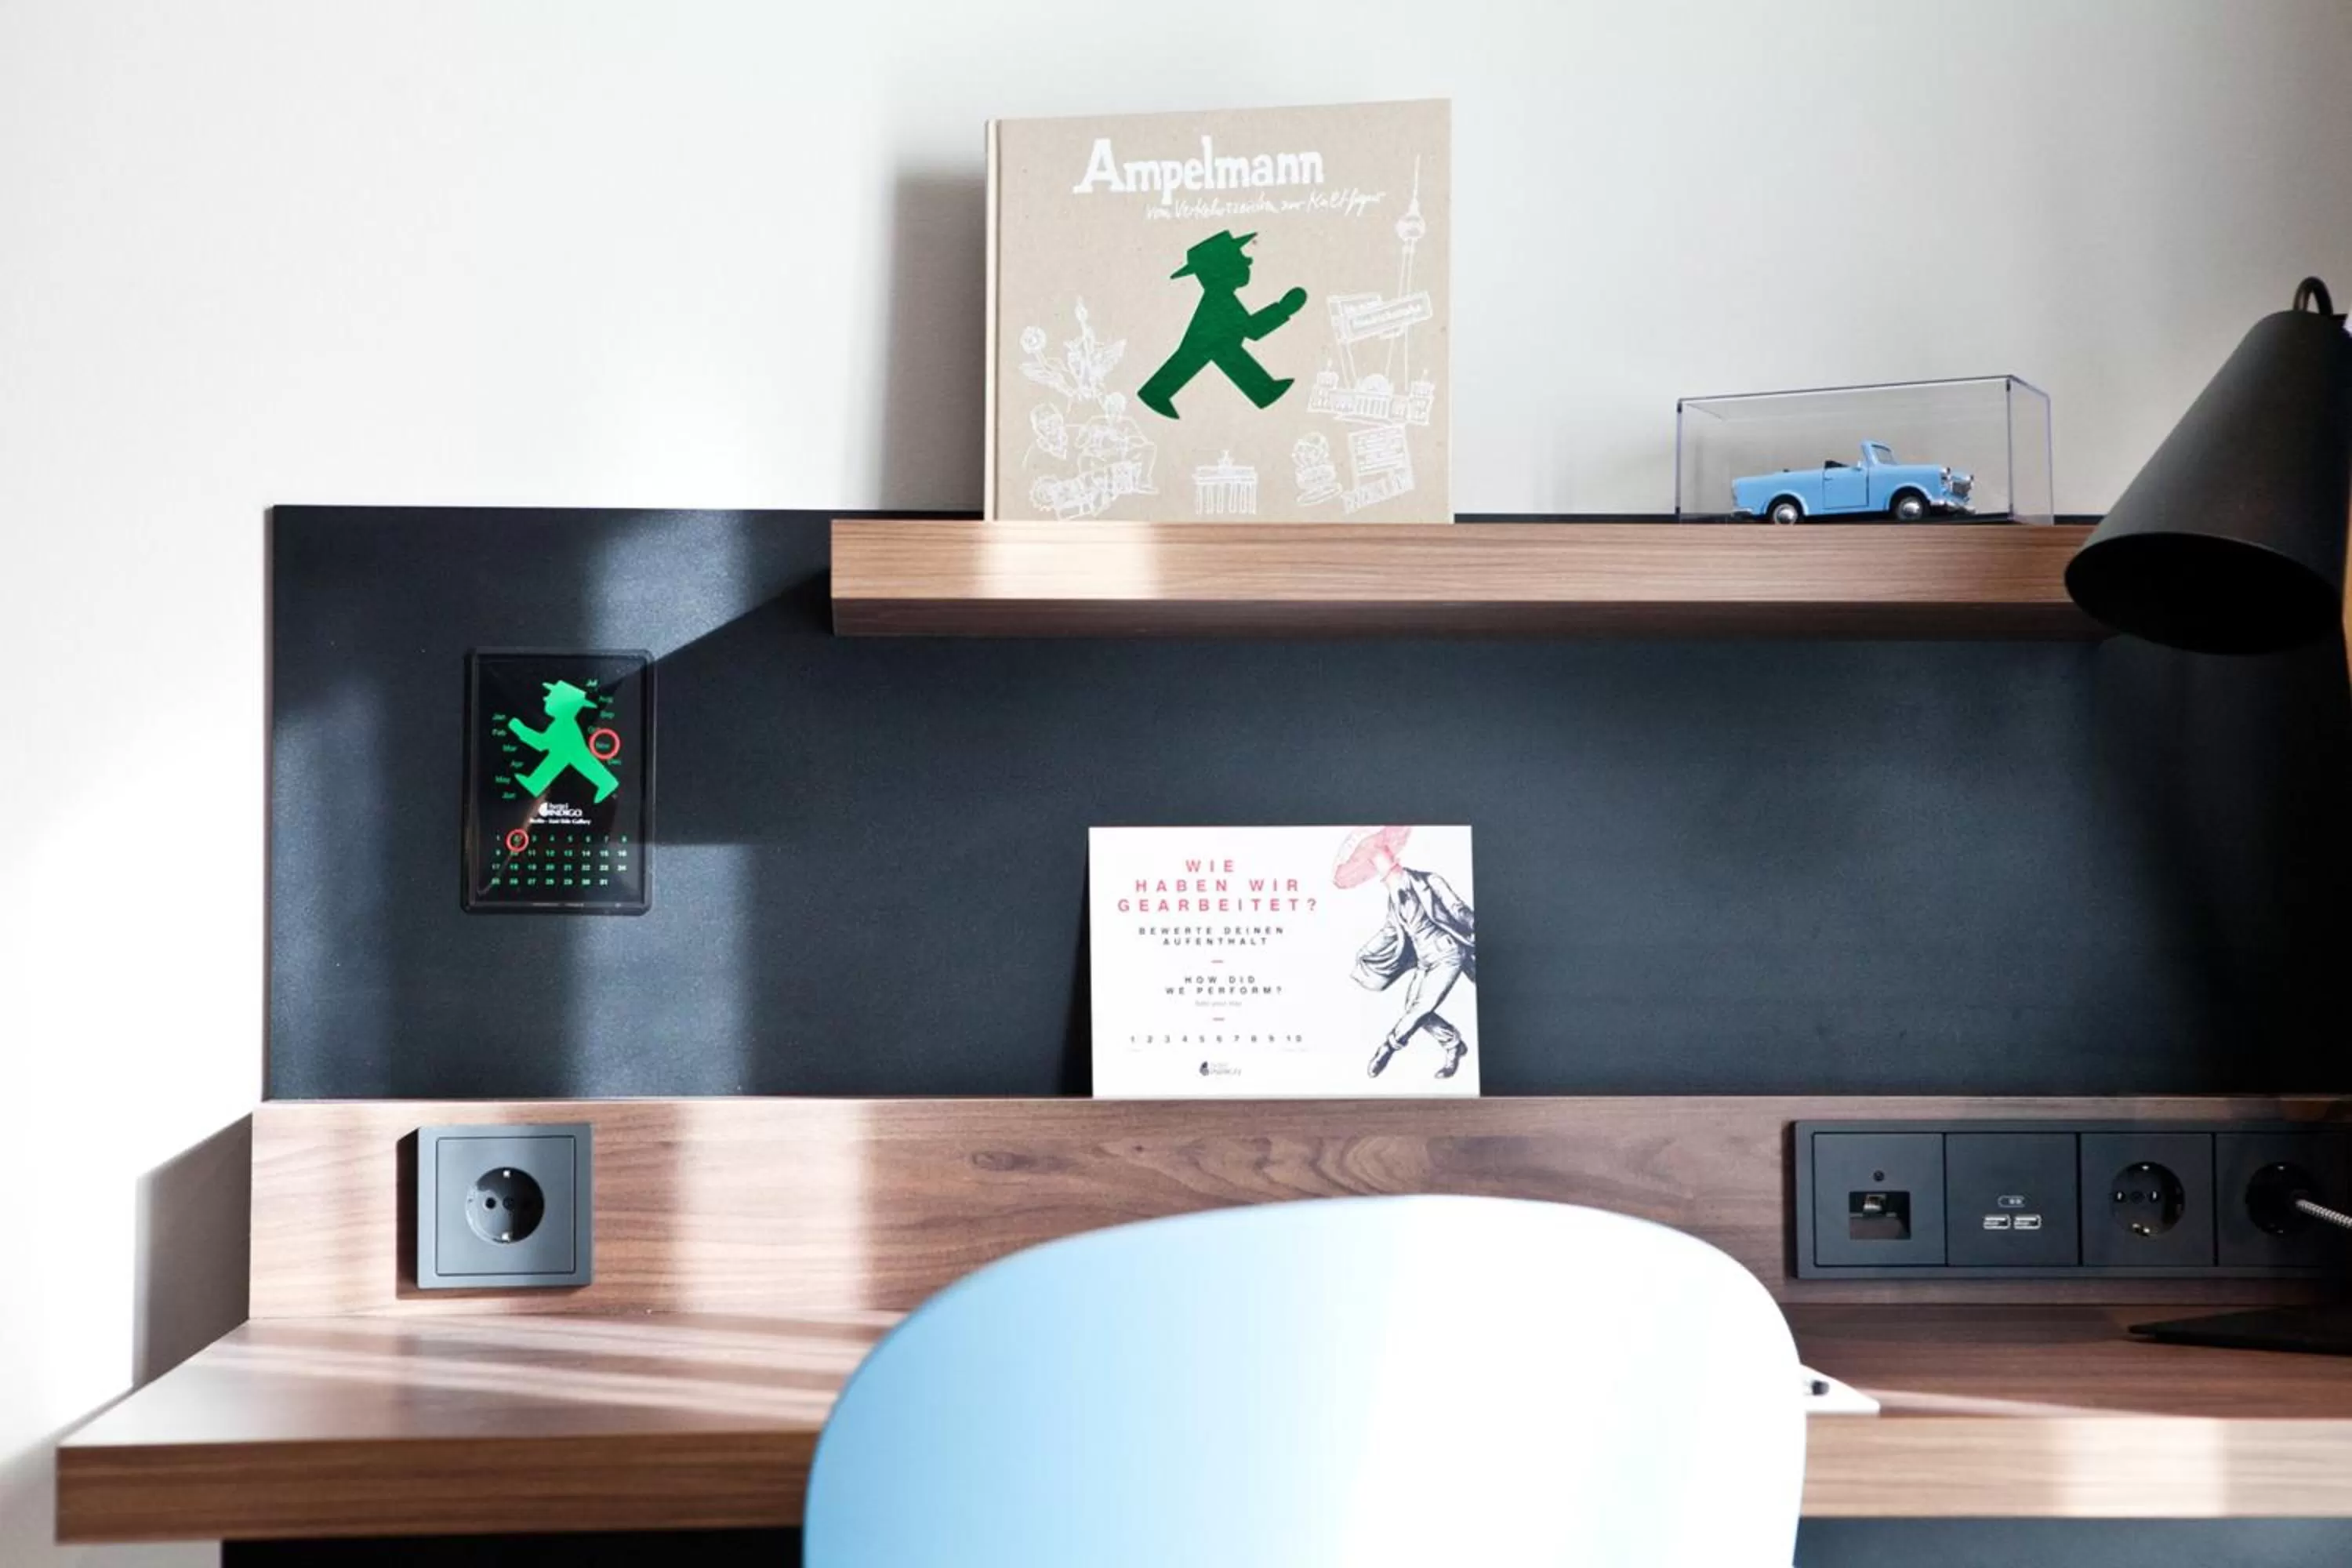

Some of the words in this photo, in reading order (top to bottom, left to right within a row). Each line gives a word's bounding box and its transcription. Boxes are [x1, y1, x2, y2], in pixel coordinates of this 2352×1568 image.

[1073, 134, 1324, 205] Ampelmann
[549, 808, 583, 817] INDIGO
[1185, 859, 1234, 873] WIE
[1135, 879, 1228, 892] HABEN
[1249, 878, 1298, 892] WIR
[1117, 898, 1317, 912] GEARBEITET?
[1138, 927, 1213, 935] BEWERTE
[1163, 937, 1268, 946] AUFENTHALT
[1185, 975, 1217, 984] HOW
[1229, 975, 1255, 984] DID
[1165, 986, 1185, 995] WE
[1196, 986, 1283, 995] PERFORM?
[1131, 1035, 1135, 1044] 1
[1147, 1035, 1153, 1044] 2
[1165, 1035, 1171, 1044] 3
[1182, 1035, 1188, 1044] 4
[1199, 1035, 1205, 1044] 5
[1216, 1035, 1222, 1044] 6
[1234, 1035, 1240, 1044] 7
[1250, 1035, 1258, 1044] 8
[1269, 1035, 1275, 1044] 9
